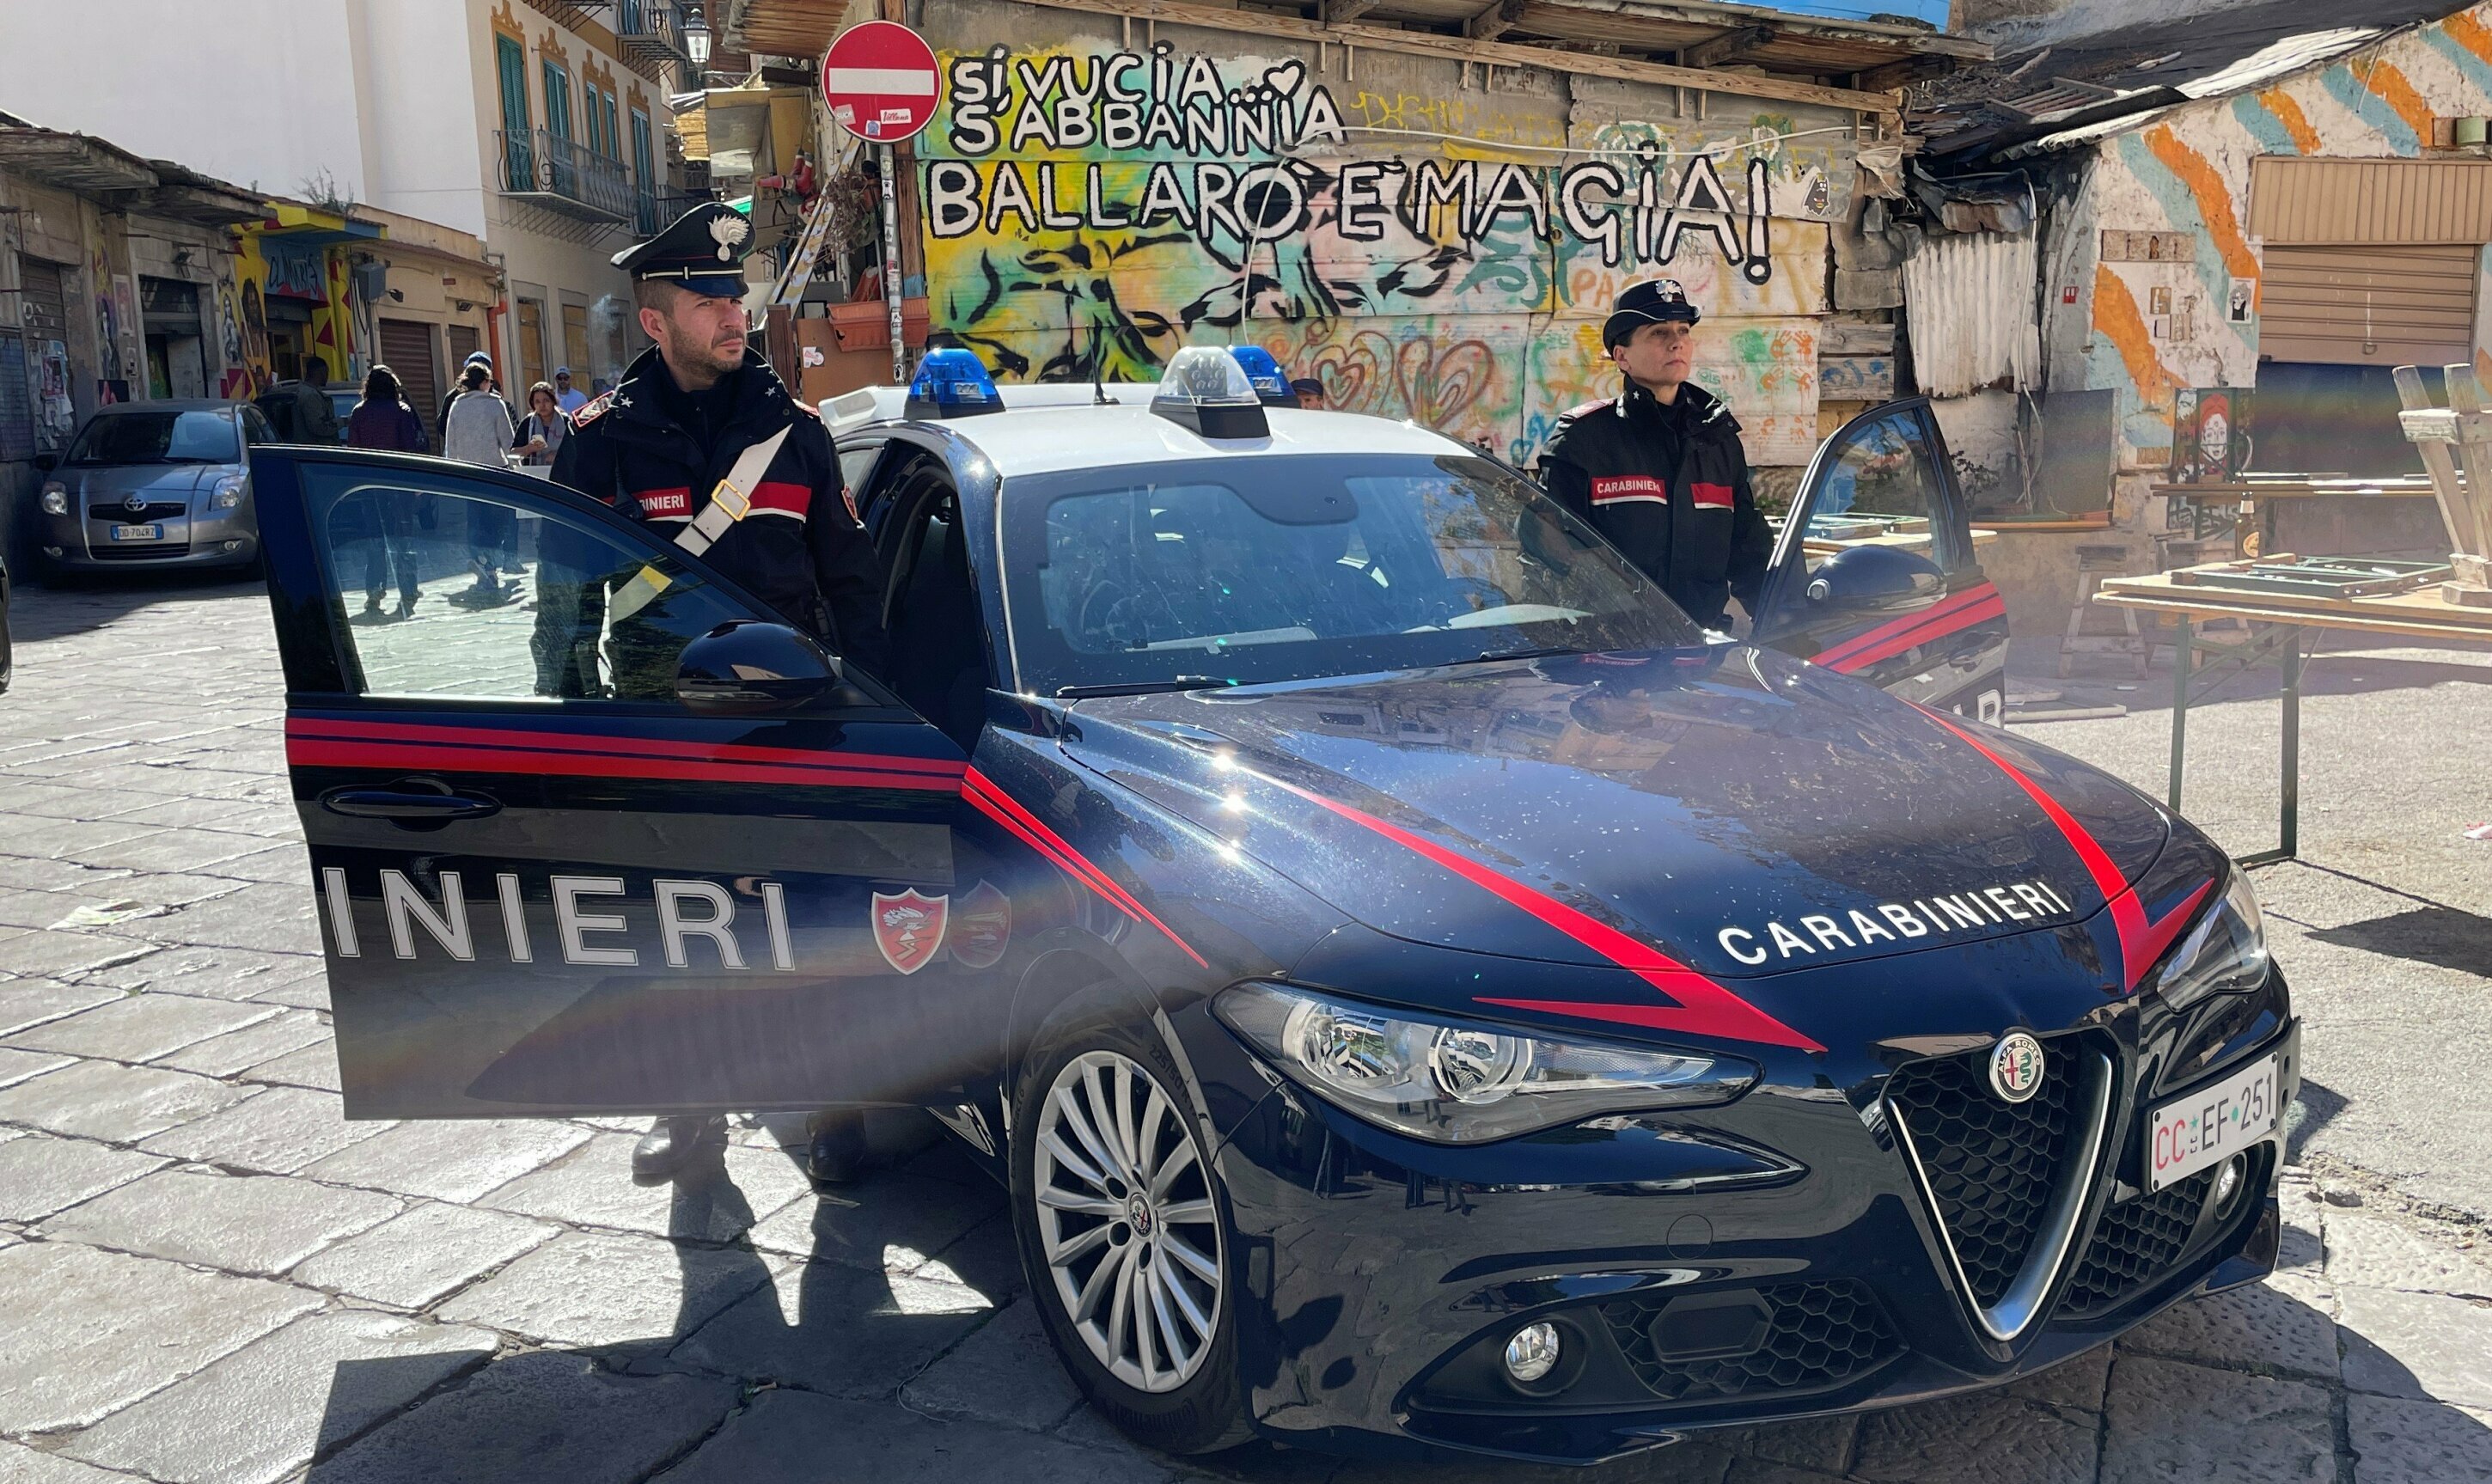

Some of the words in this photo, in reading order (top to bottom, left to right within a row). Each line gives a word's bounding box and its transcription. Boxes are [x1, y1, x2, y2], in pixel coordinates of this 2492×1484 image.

[1597, 479, 1661, 494] CARABINIERI
[322, 867, 796, 971] INIERI
[1718, 881, 2072, 966] CARABINIERI
[1998, 1045, 2013, 1073] ALFA
[2015, 1039, 2041, 1066] ROMEO
[2155, 1118, 2186, 1170] CC
[2202, 1097, 2229, 1151] EF
[2240, 1072, 2272, 1131] 251
